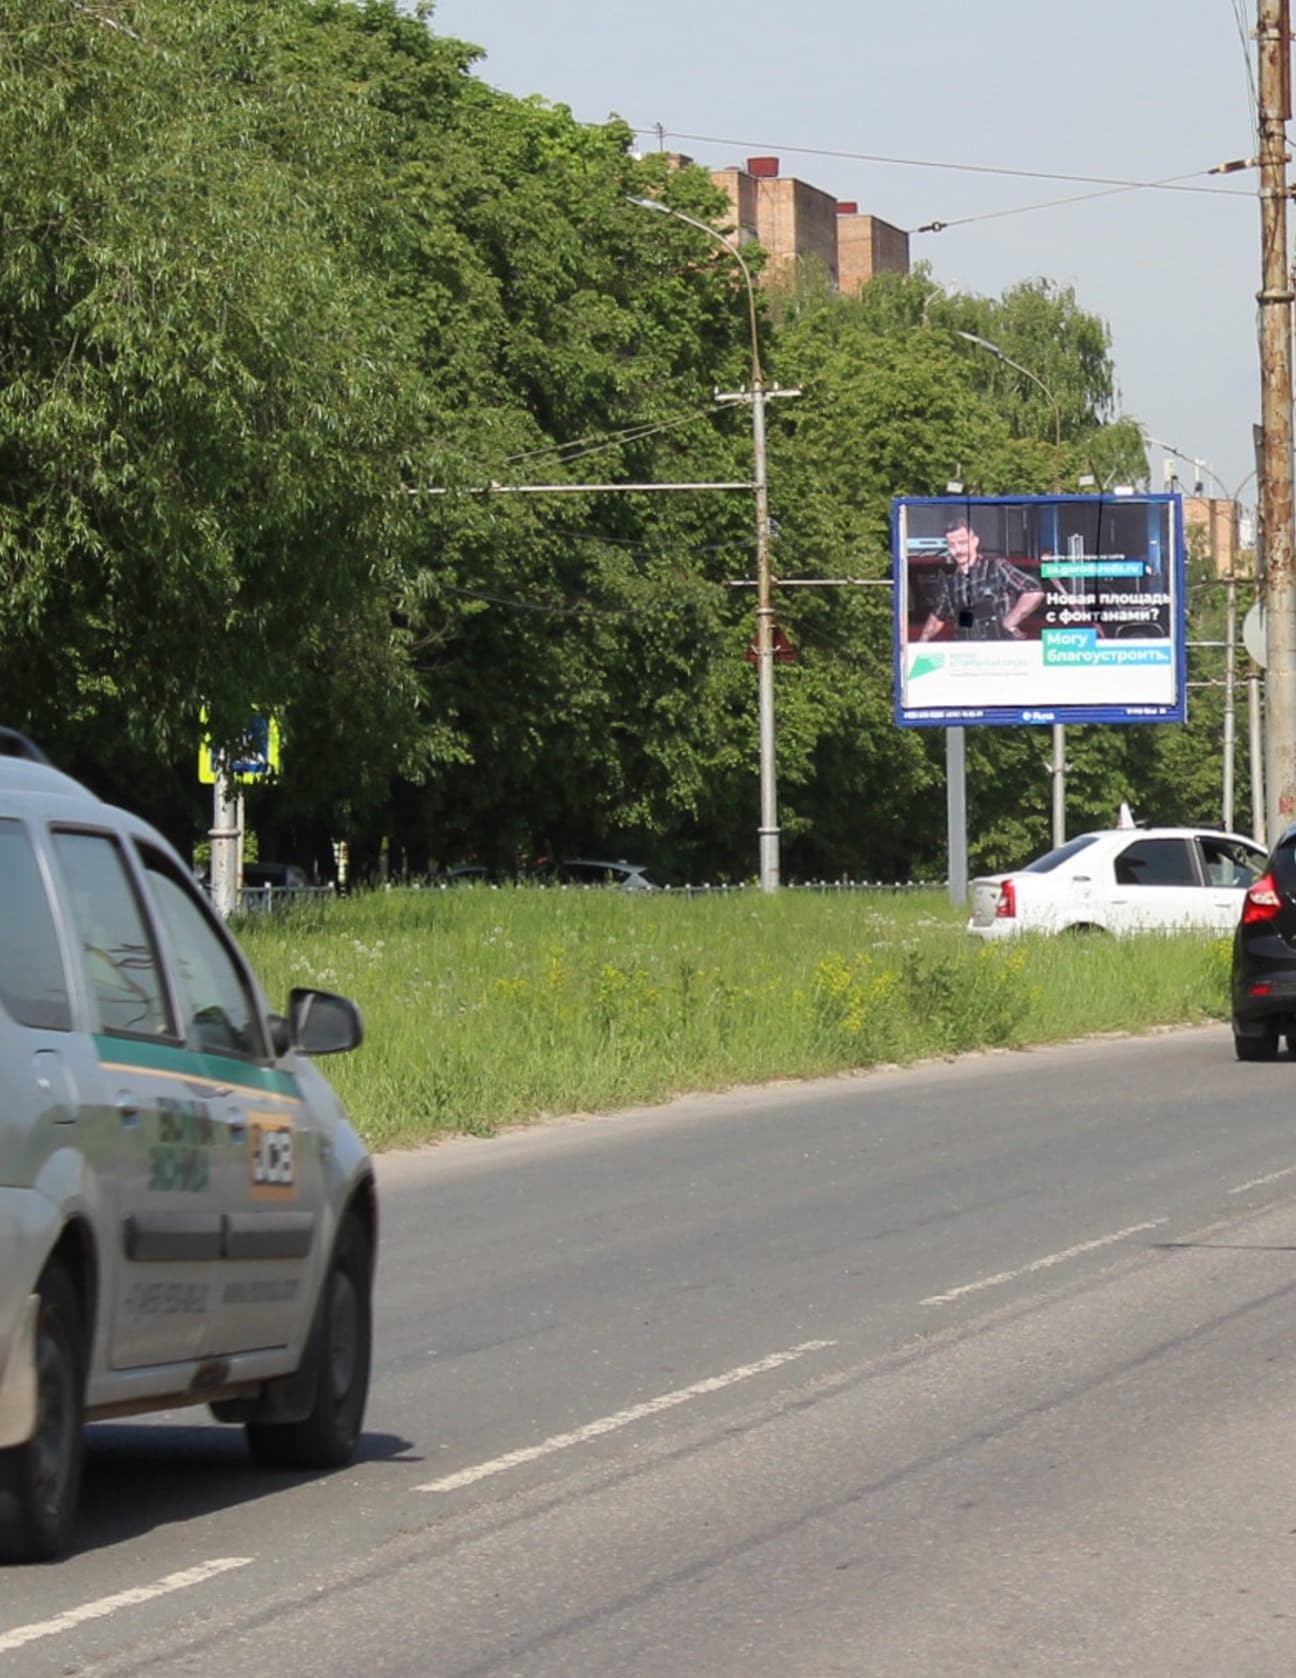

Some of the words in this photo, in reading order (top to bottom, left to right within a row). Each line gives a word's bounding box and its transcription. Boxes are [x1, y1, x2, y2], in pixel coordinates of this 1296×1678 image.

[1046, 592, 1096, 605] Новая
[1099, 593, 1171, 606] площадь
[1045, 611, 1056, 622] с
[1058, 608, 1160, 624] фонтанами?
[1046, 633, 1089, 648] Могу
[1046, 649, 1169, 665] благоустроить.
